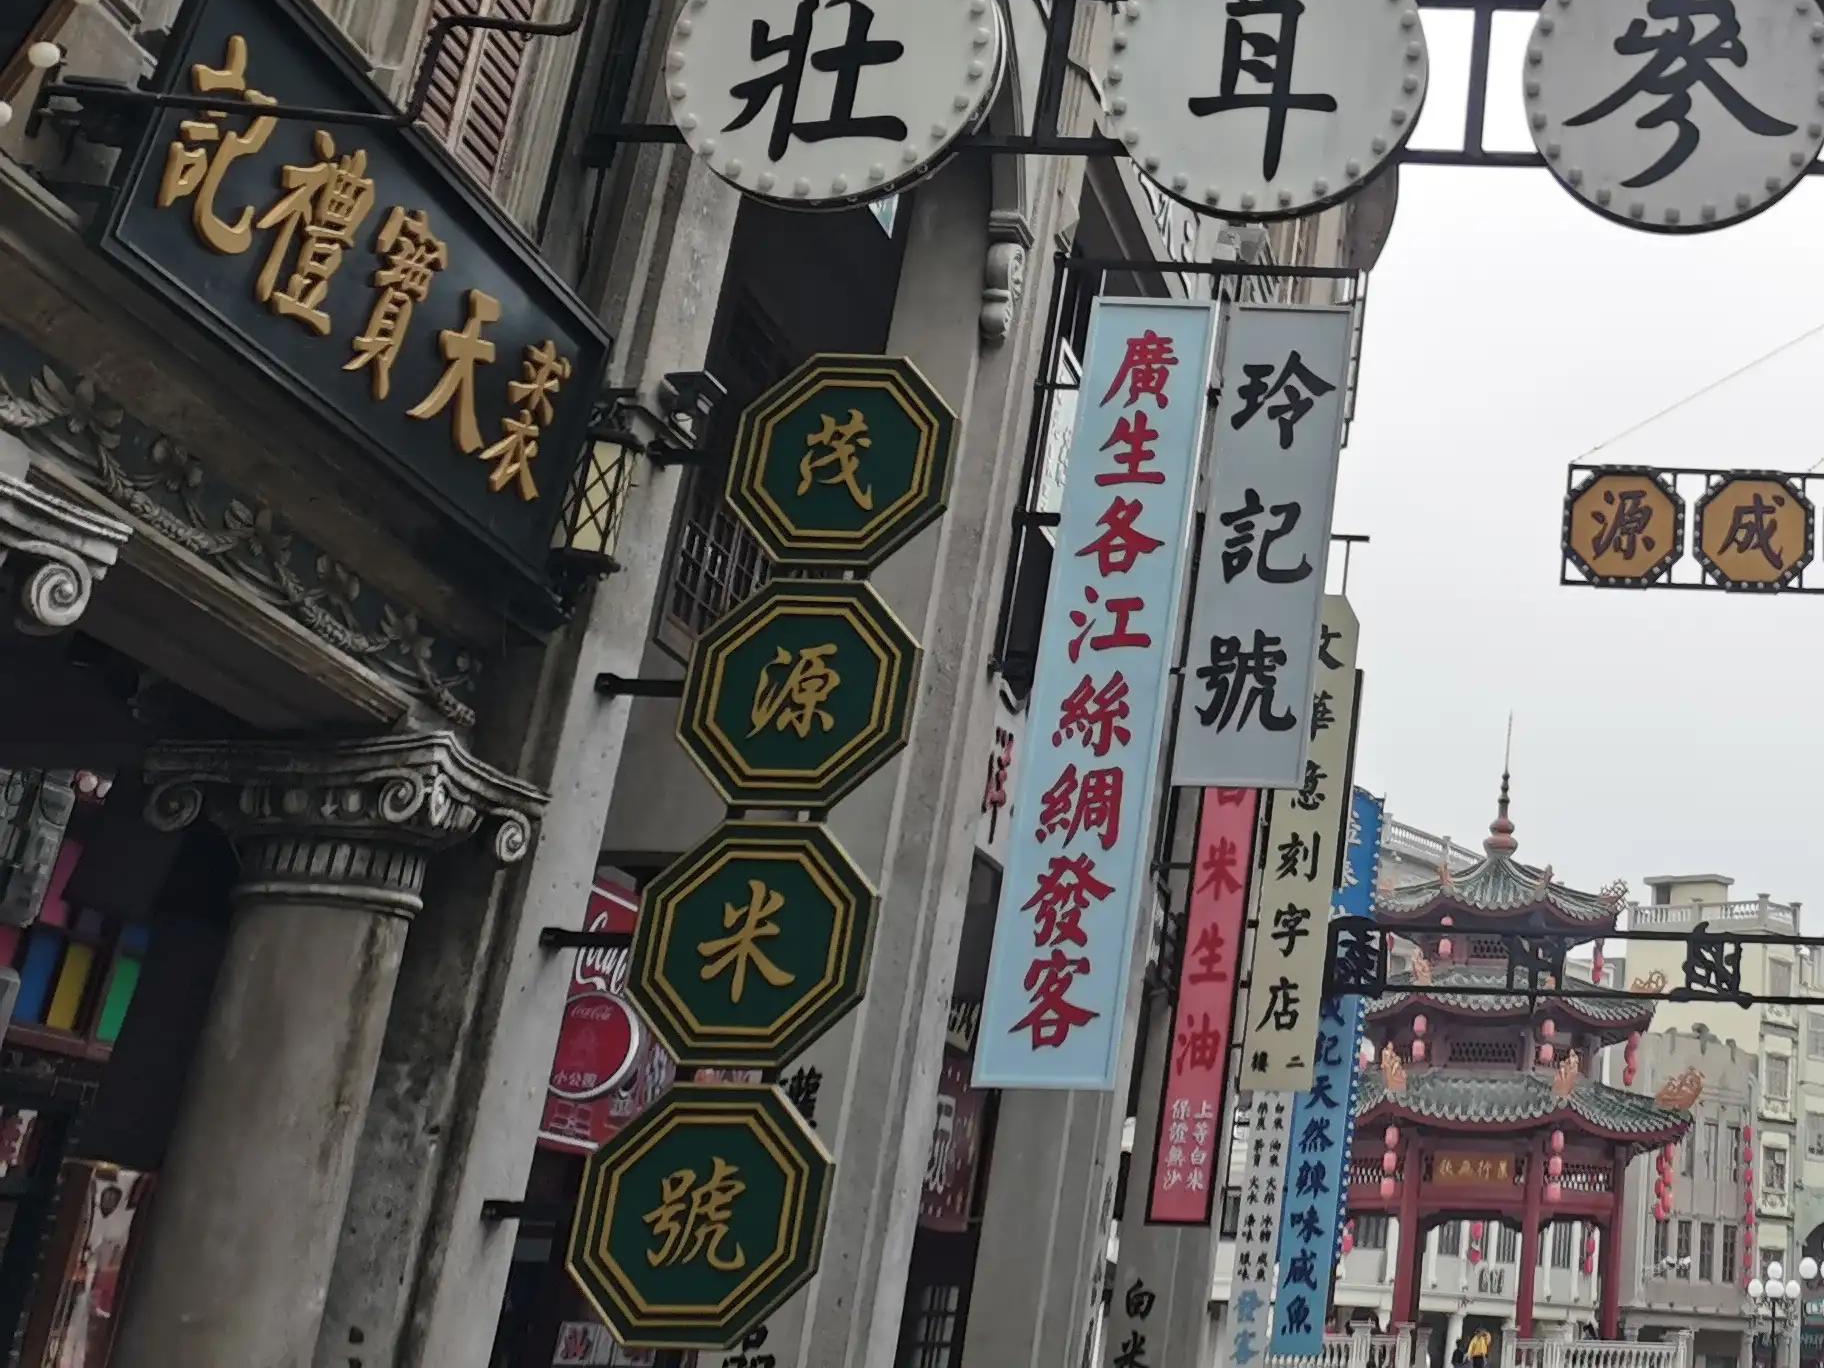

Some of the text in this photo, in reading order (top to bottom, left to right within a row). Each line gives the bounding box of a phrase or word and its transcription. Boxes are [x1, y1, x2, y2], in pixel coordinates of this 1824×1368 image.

[642, 406, 876, 1273] 茂源米號
[1008, 329, 1180, 1052] 廣生各江絲綢發客
[1194, 349, 1337, 735] 玲記號
